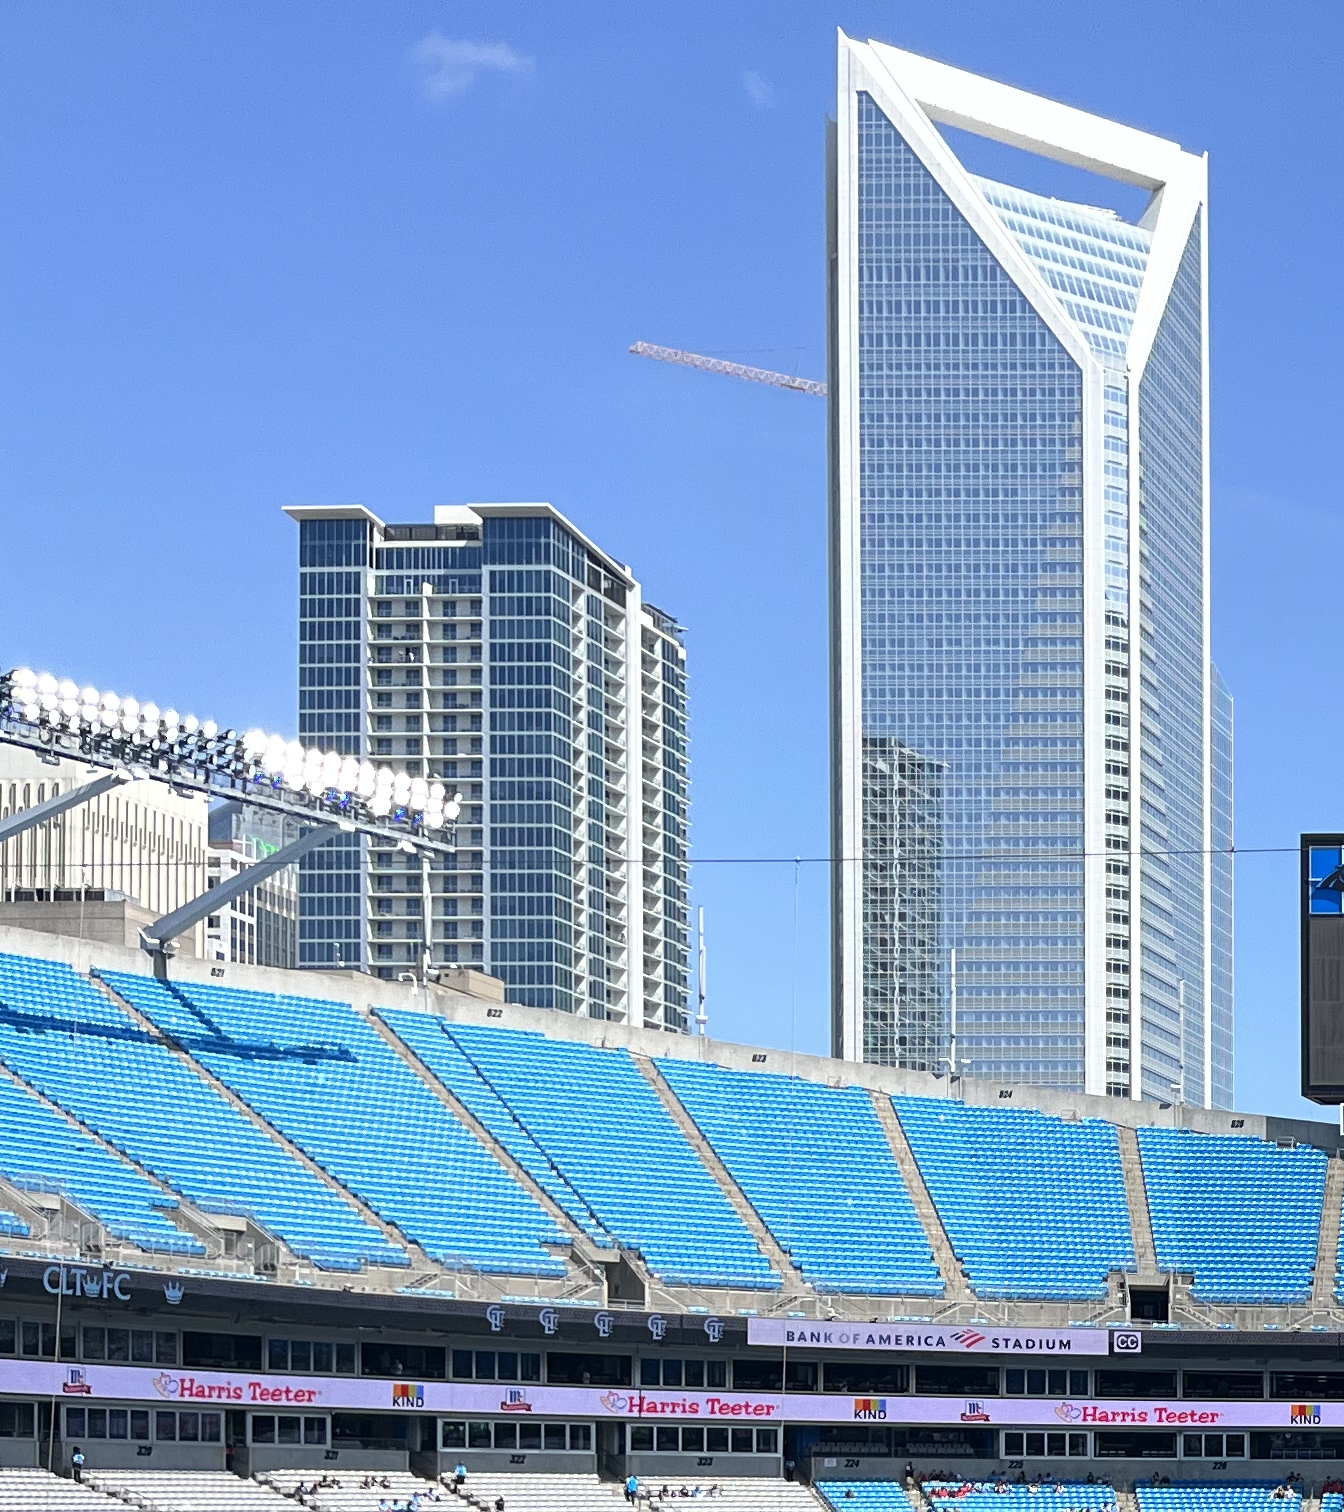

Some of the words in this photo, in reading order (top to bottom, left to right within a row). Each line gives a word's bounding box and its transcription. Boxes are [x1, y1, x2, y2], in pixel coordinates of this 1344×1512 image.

[786, 1330, 835, 1344] BANK
[838, 1333, 861, 1344] OF
[865, 1334, 946, 1348] AMERICA
[991, 1337, 1072, 1351] STADIUM
[178, 1377, 243, 1401] Harris
[249, 1381, 317, 1404] Teeter
[392, 1395, 424, 1409] KIND
[627, 1395, 699, 1416] Harris
[705, 1398, 776, 1417] Teeter
[854, 1409, 887, 1420] KIND
[1082, 1407, 1148, 1424] Harris
[1153, 1407, 1220, 1424] Teeter
[1290, 1415, 1321, 1425] KIND
